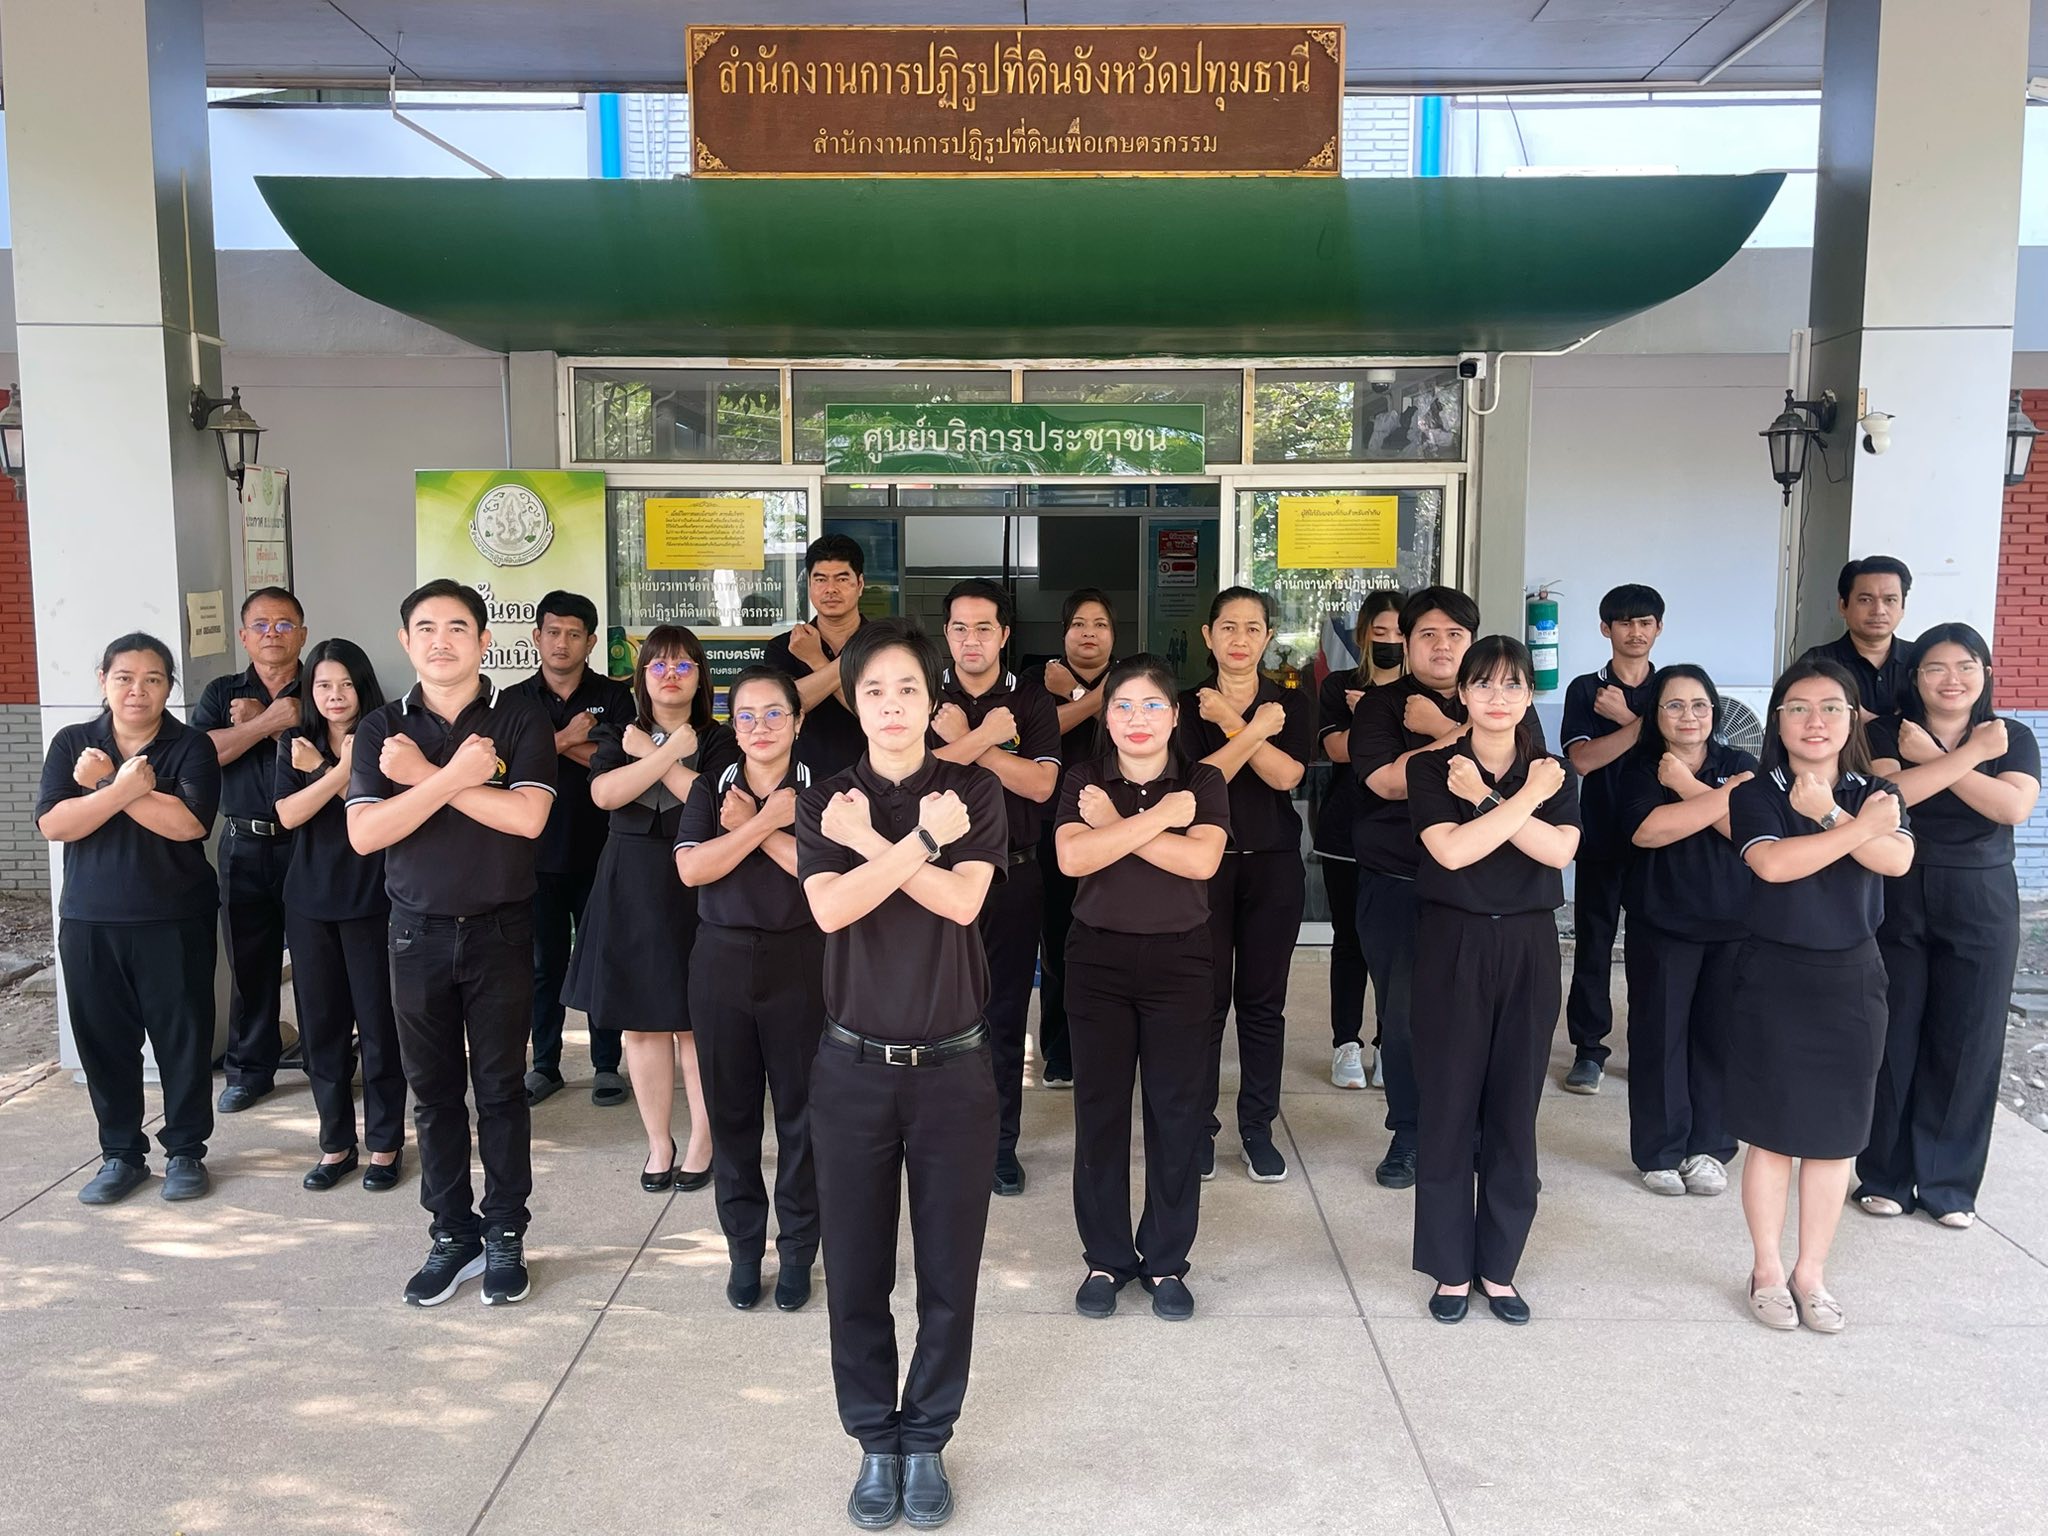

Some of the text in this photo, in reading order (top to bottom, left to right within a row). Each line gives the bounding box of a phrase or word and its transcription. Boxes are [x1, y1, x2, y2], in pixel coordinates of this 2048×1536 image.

[718, 31, 1311, 112] สำนักงานการปฏิรูปที่ดินจังหวัดปทุมธานี
[812, 118, 1218, 164] สำนักงานการปฏิรูปที่ดินเพื่อเกษตรกรรม
[863, 415, 1167, 464] ศูนย์บริการประชาชน
[1317, 597, 1365, 614] จังหวัดป
